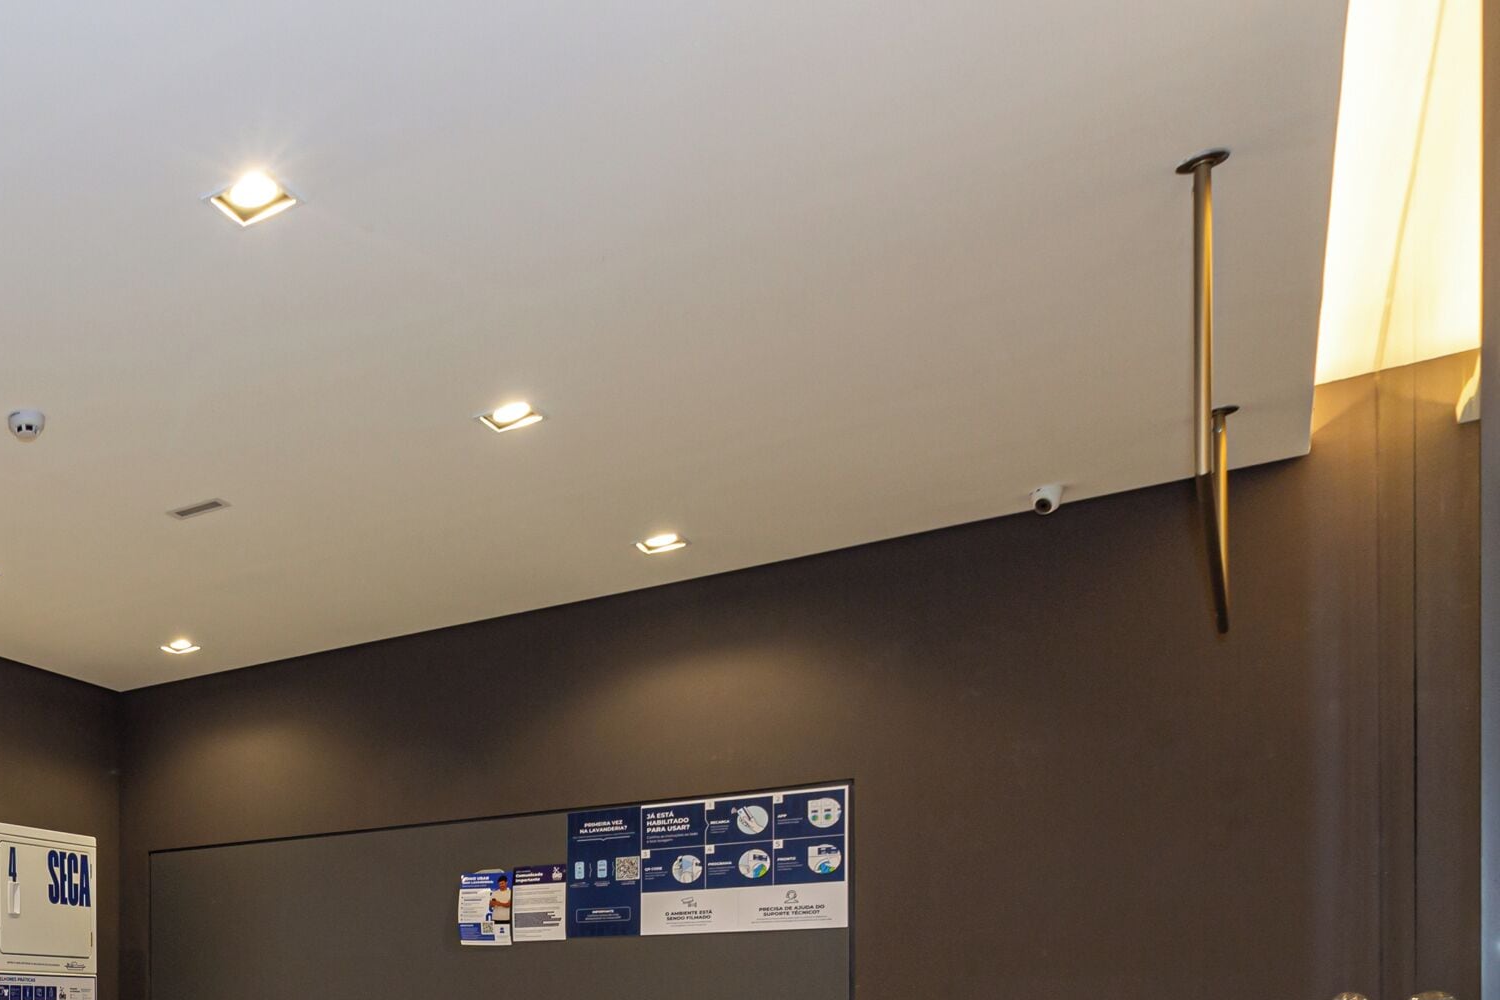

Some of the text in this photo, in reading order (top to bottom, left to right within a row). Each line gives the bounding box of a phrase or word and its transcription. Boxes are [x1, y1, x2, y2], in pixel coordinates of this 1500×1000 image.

[646, 817, 690, 826] HABILITADO
[668, 824, 690, 832] USAR?
[8, 847, 17, 882] 4
[48, 850, 91, 907] SECA
